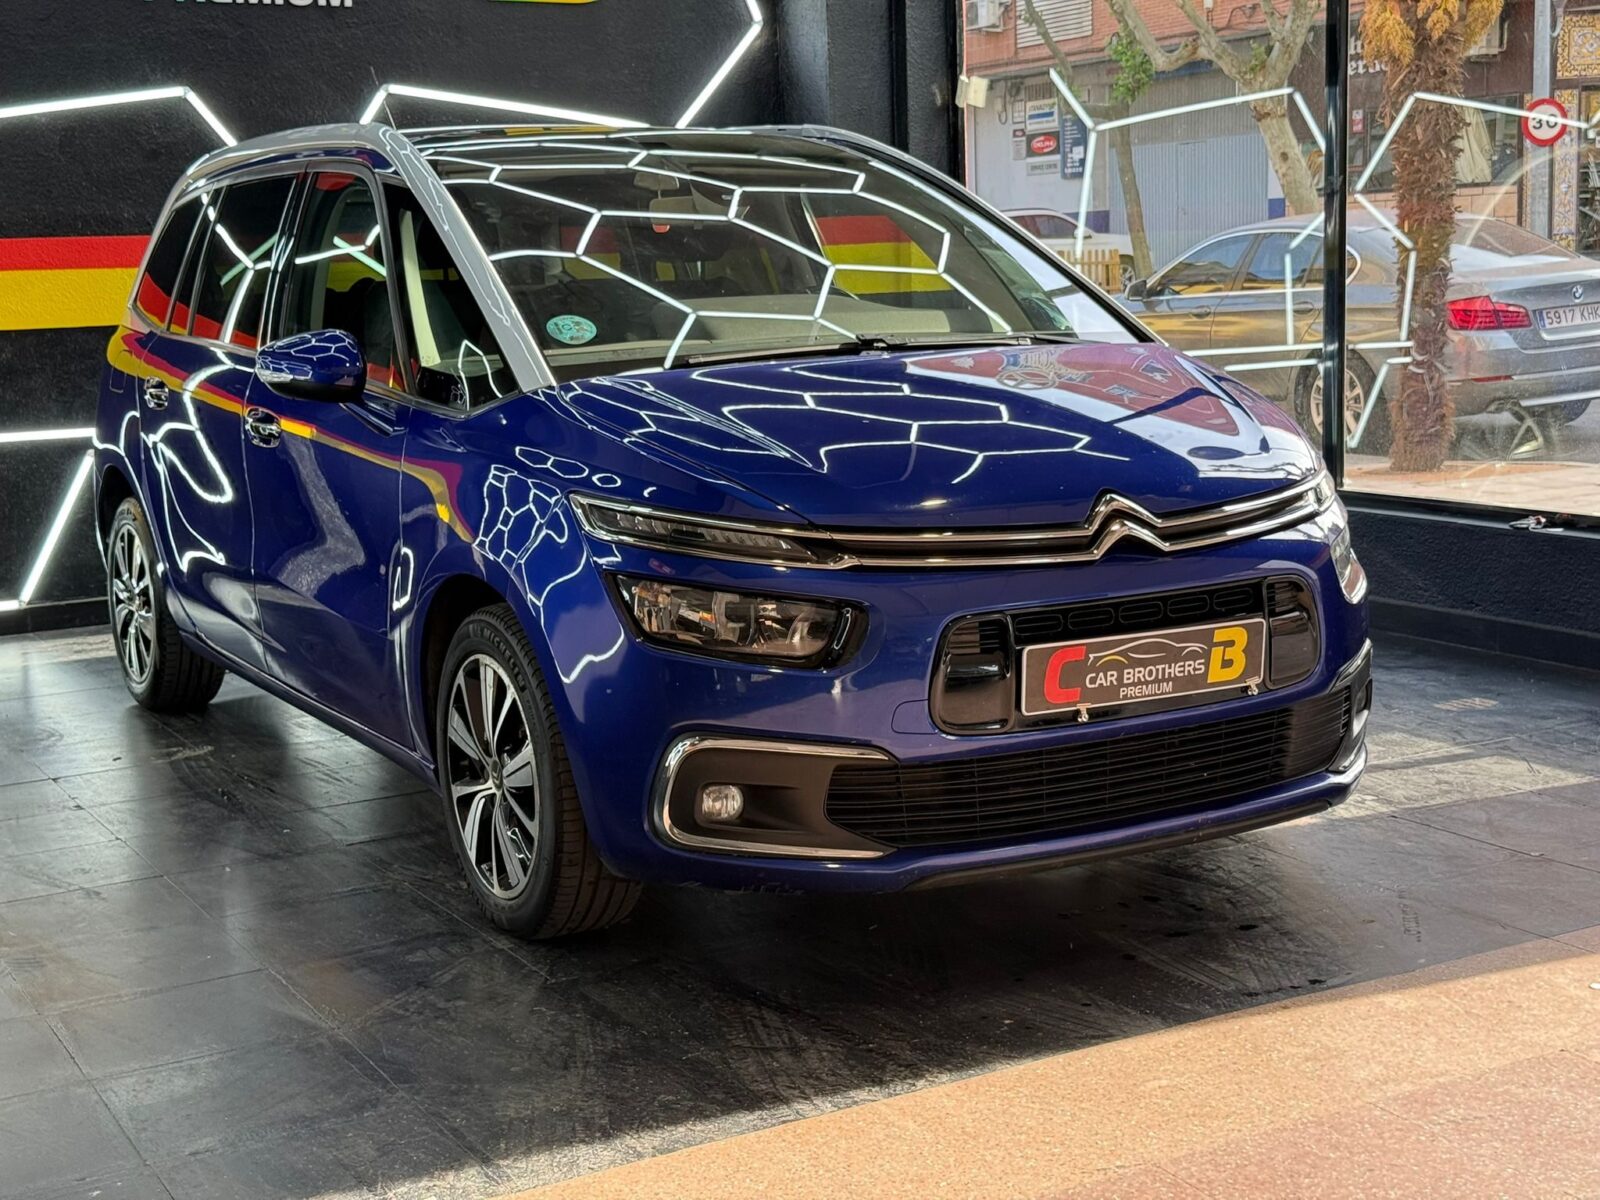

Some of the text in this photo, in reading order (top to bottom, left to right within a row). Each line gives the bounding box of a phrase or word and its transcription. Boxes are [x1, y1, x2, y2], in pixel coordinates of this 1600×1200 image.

[1532, 114, 1558, 130] 30
[1545, 309, 1575, 325] 5917
[1206, 626, 1248, 684] B
[1043, 645, 1087, 704] C
[1085, 659, 1205, 689] CAR BROTHERS
[1119, 681, 1173, 699] PREMIUM
